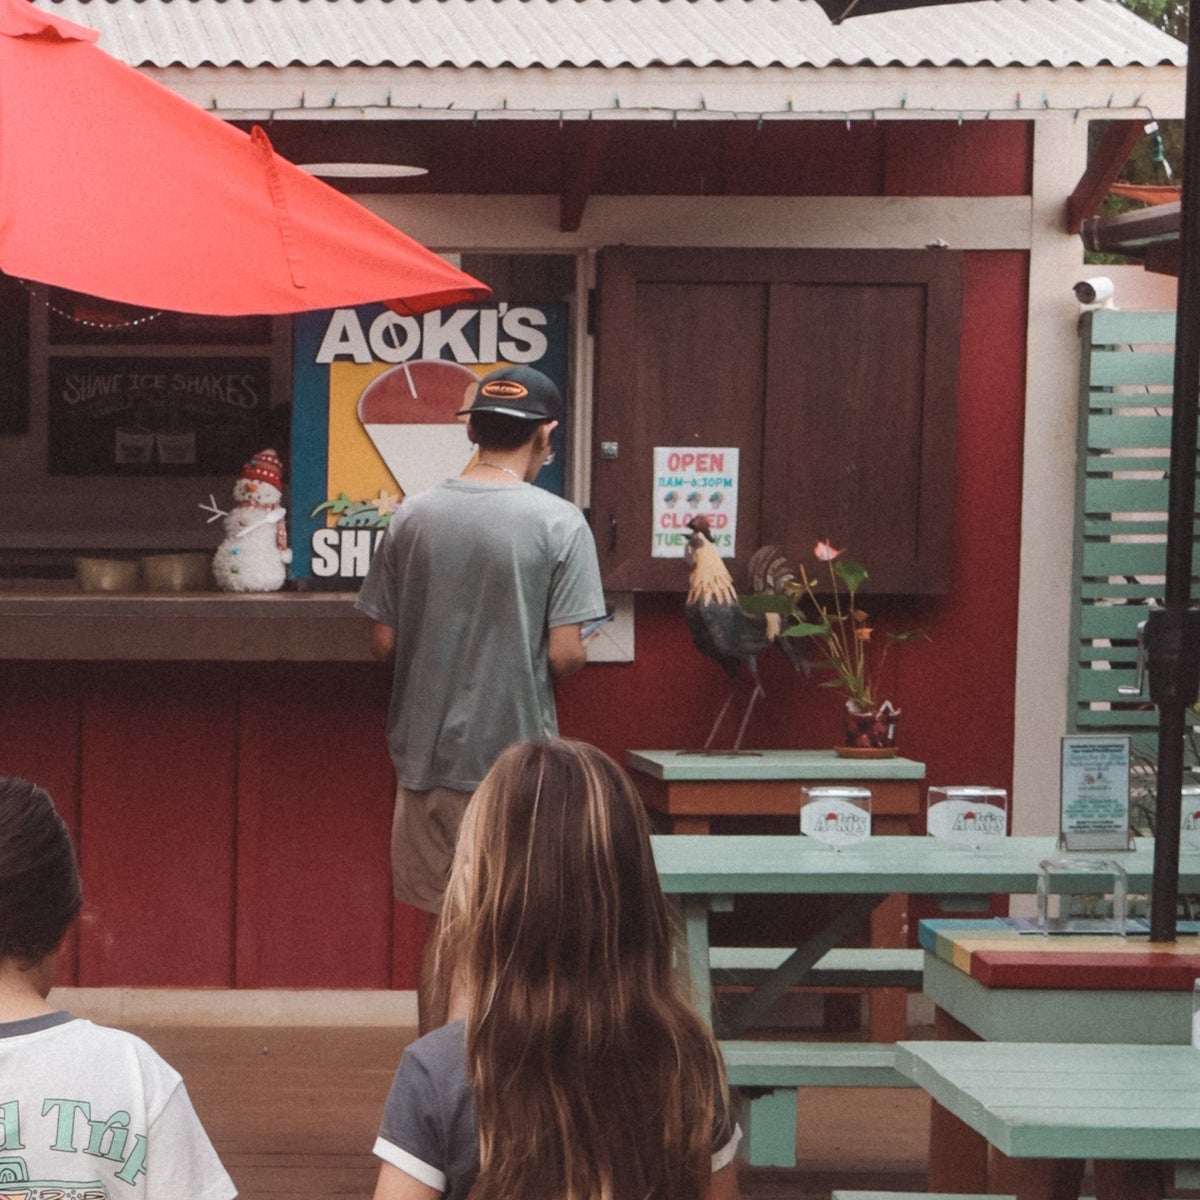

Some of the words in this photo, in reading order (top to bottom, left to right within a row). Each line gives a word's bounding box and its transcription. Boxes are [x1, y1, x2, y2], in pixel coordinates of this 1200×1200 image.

[315, 303, 548, 364] AOKI'S
[129, 375, 168, 390] ICE
[171, 373, 259, 409] SHAKES
[668, 453, 724, 473] OPEN
[660, 512, 728, 529] CLOED
[655, 532, 732, 547] TUEYS
